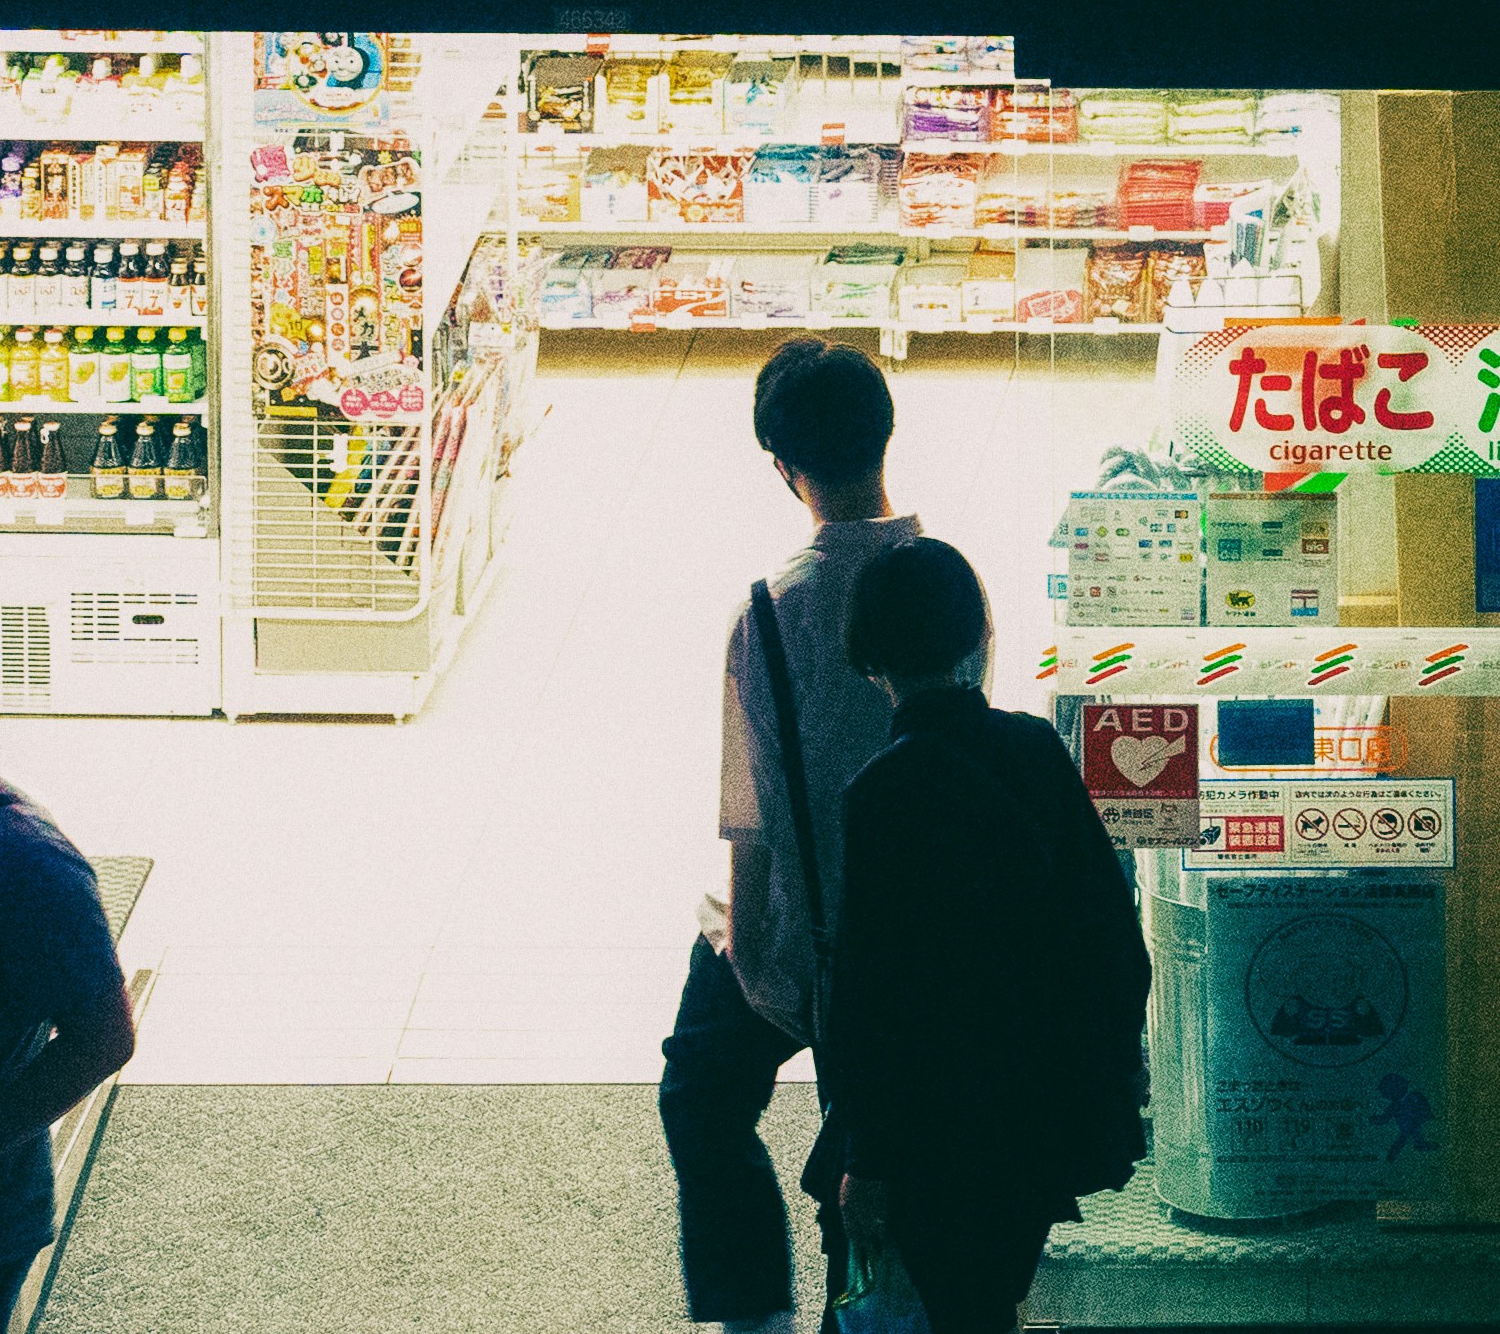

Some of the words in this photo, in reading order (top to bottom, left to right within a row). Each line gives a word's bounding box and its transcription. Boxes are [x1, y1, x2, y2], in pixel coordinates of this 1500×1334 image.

[559, 9, 627, 29] 466342
[1229, 343, 1435, 434] たばこ
[1269, 439, 1394, 466] cigarette
[1092, 708, 1189, 732] AED
